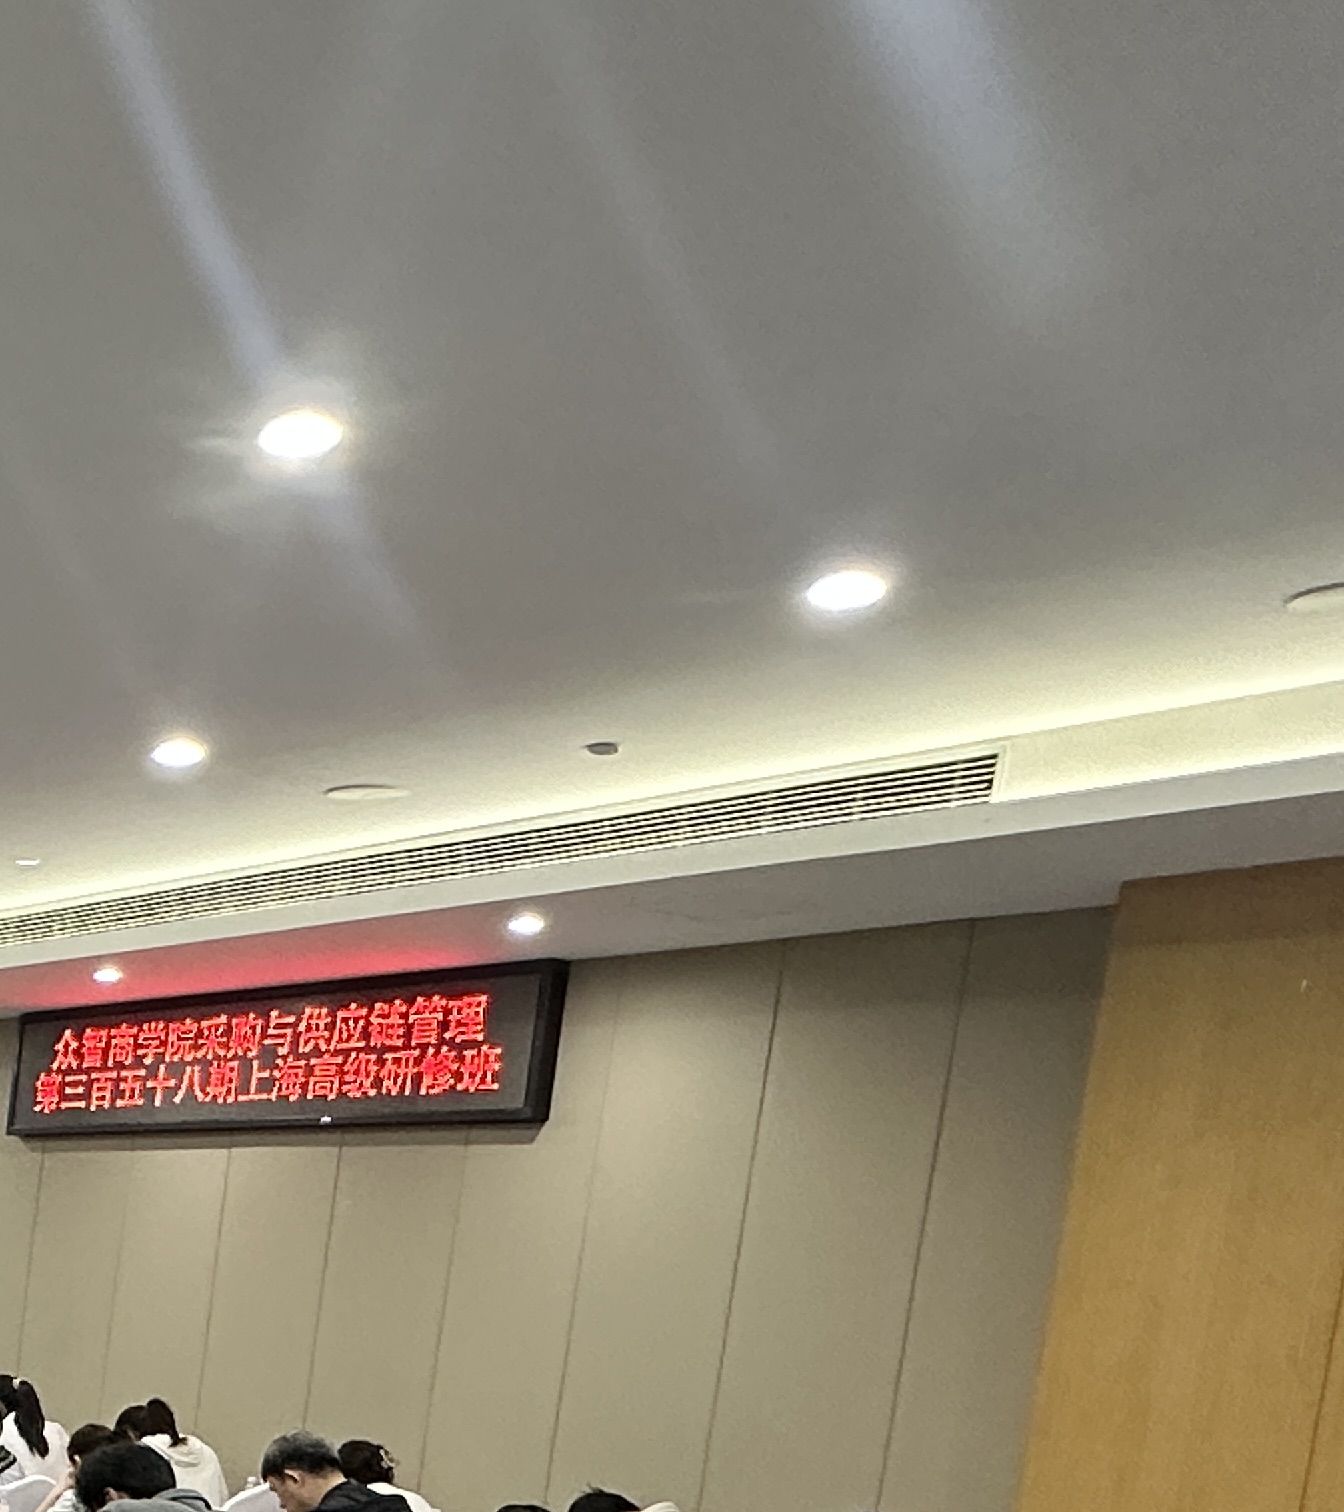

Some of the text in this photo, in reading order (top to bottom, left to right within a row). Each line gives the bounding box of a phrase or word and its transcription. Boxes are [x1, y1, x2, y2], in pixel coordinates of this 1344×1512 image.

[50, 994, 489, 1071] 众智商学院采购与供应链管理
[33, 1044, 502, 1113] 第三百五十八期上海高级研修班
